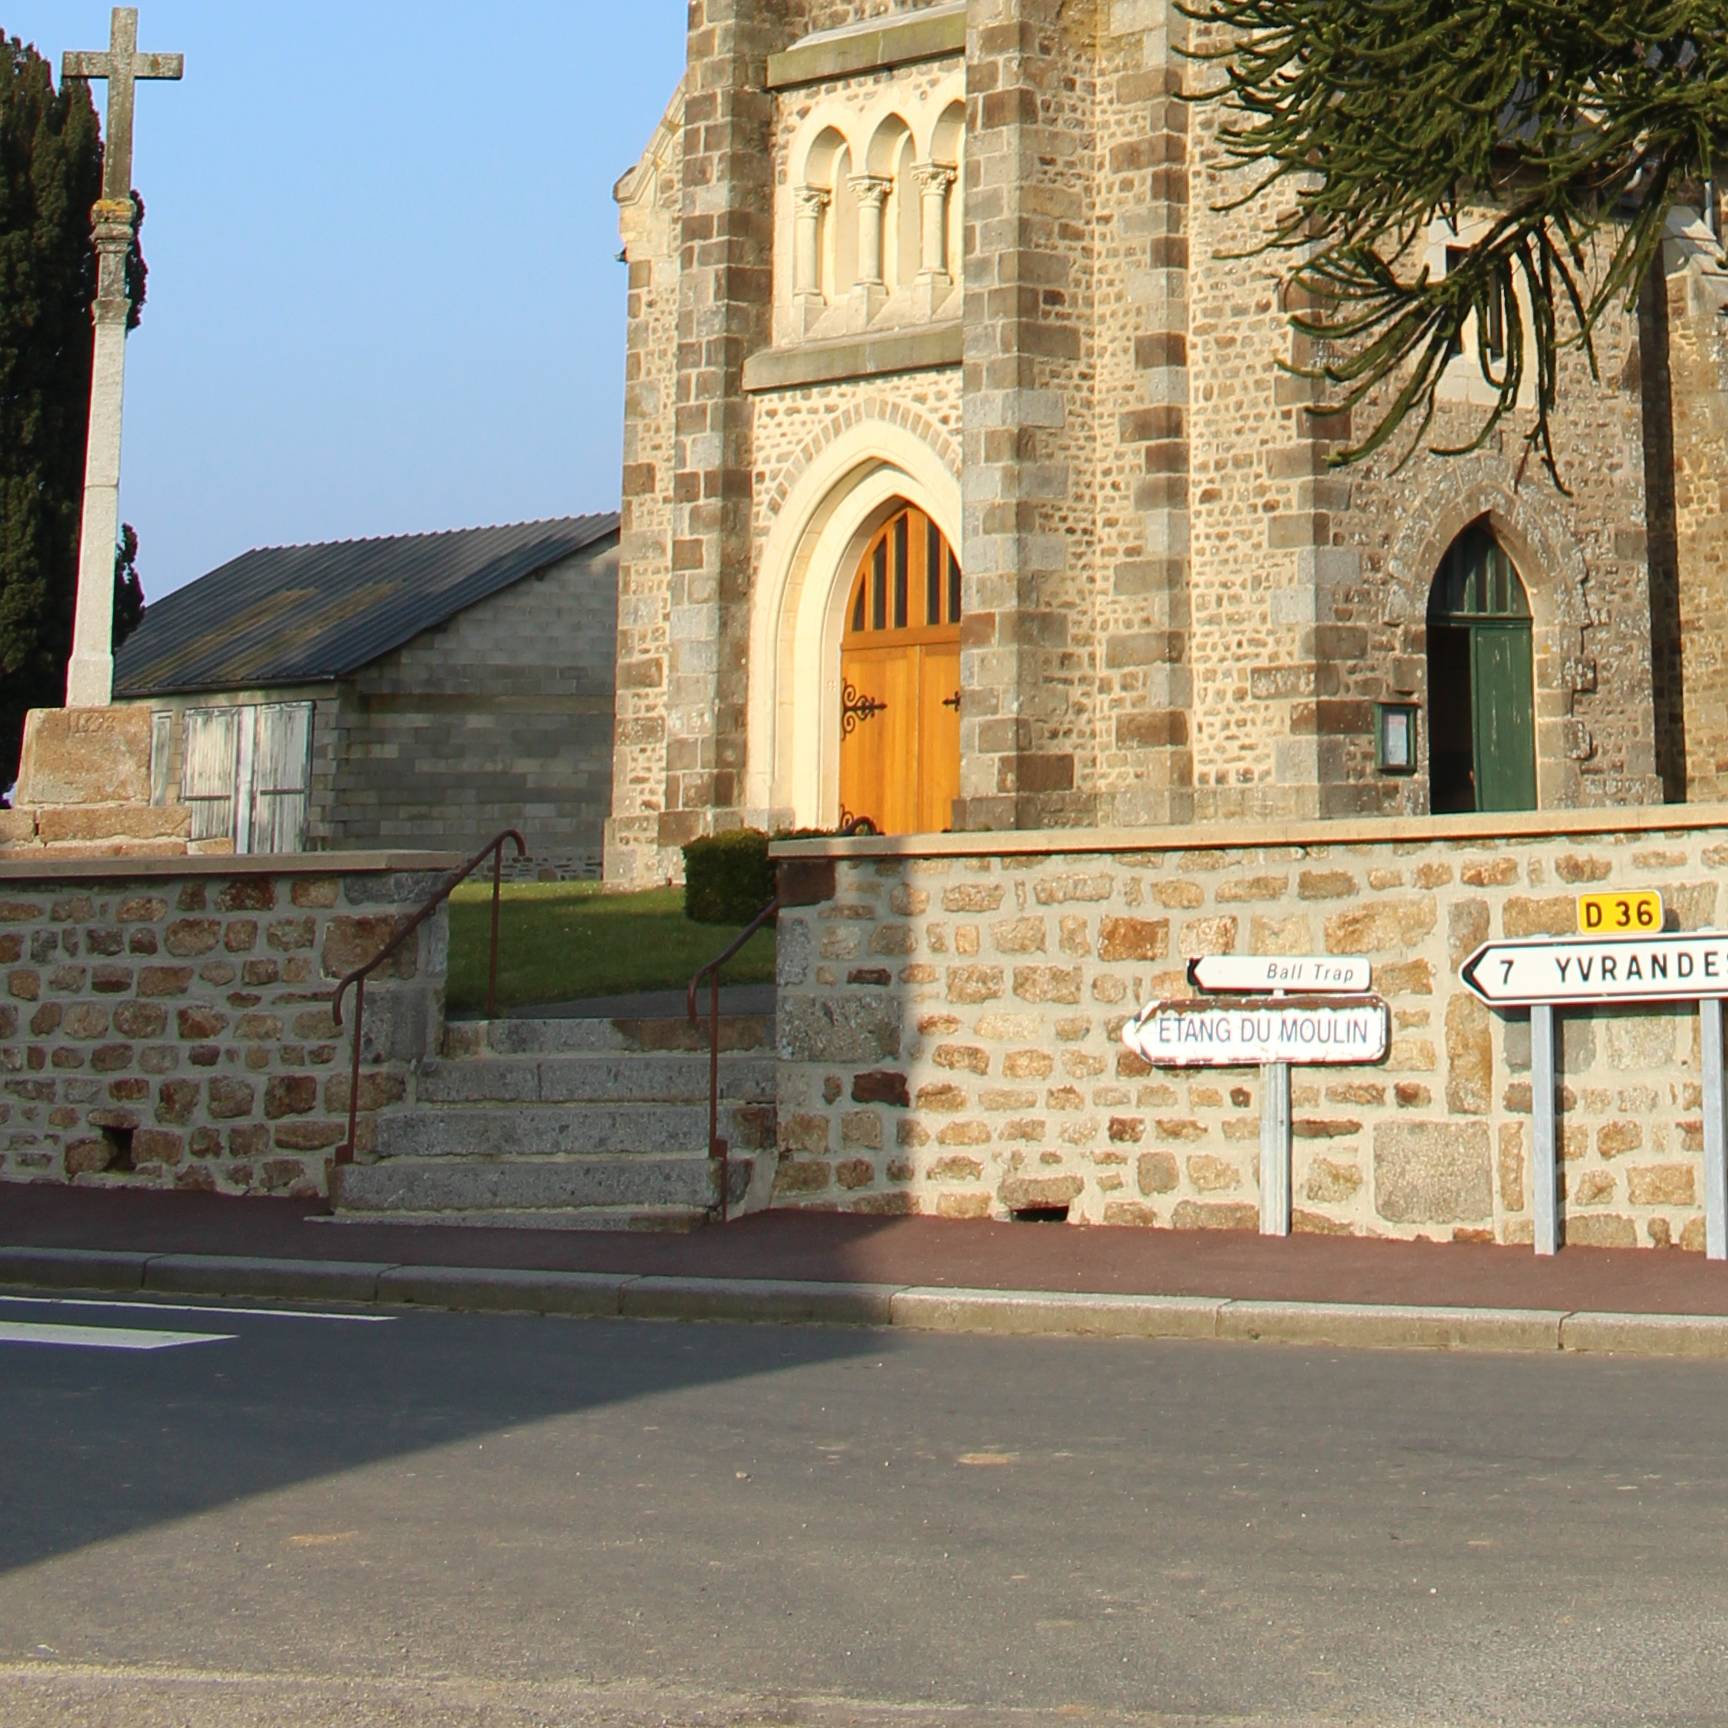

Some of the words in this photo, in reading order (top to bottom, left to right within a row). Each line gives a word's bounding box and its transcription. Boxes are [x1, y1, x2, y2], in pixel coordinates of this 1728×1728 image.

[1585, 902, 1602, 928] D
[1615, 900, 1653, 926] 36
[1266, 963, 1303, 980] Ball
[1314, 964, 1354, 983] Trap
[1500, 960, 1514, 985] 7
[1159, 1017, 1231, 1043] ETANG
[1241, 1018, 1270, 1043] DU
[1280, 1019, 1368, 1044] MOULIN
